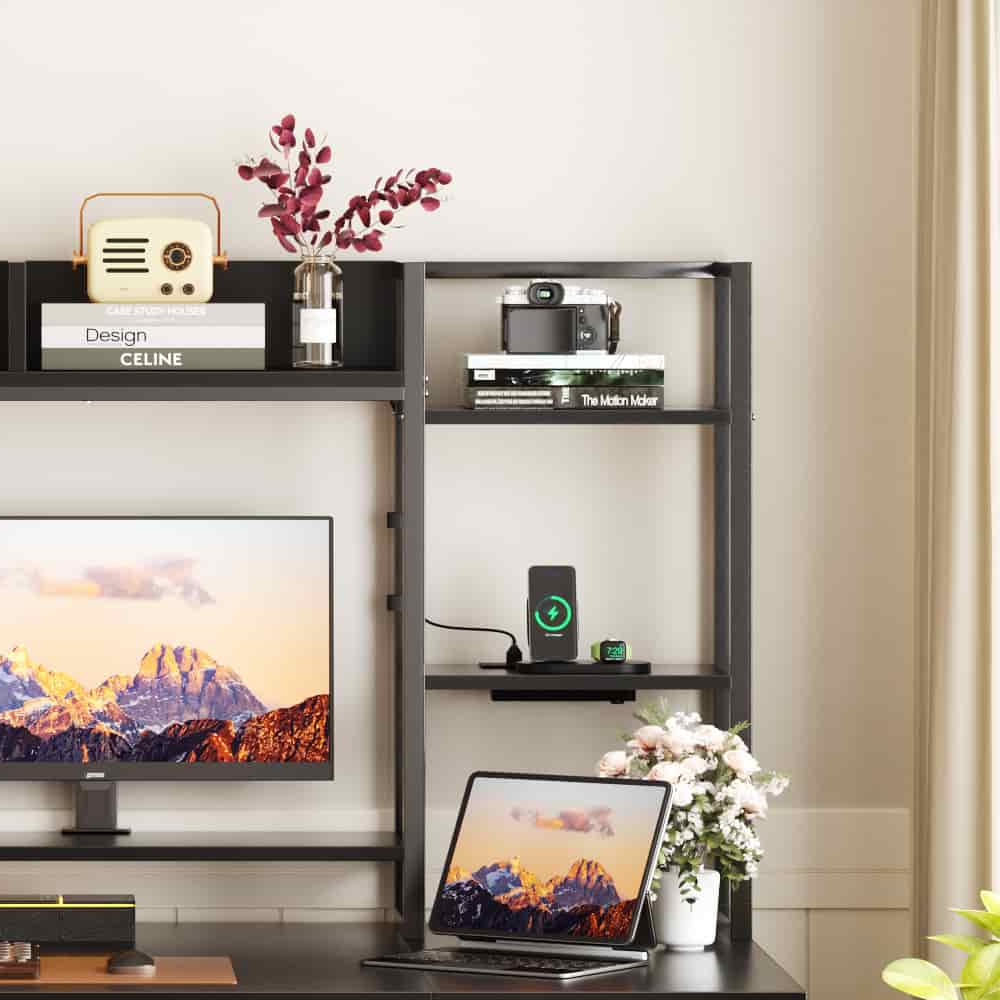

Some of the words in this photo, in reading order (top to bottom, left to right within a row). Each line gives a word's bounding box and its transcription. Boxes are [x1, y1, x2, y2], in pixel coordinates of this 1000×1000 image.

[86, 327, 147, 346] Design
[120, 352, 182, 366] CELINE
[581, 394, 599, 407] The
[600, 394, 628, 407] Motion
[630, 394, 658, 407] Maker
